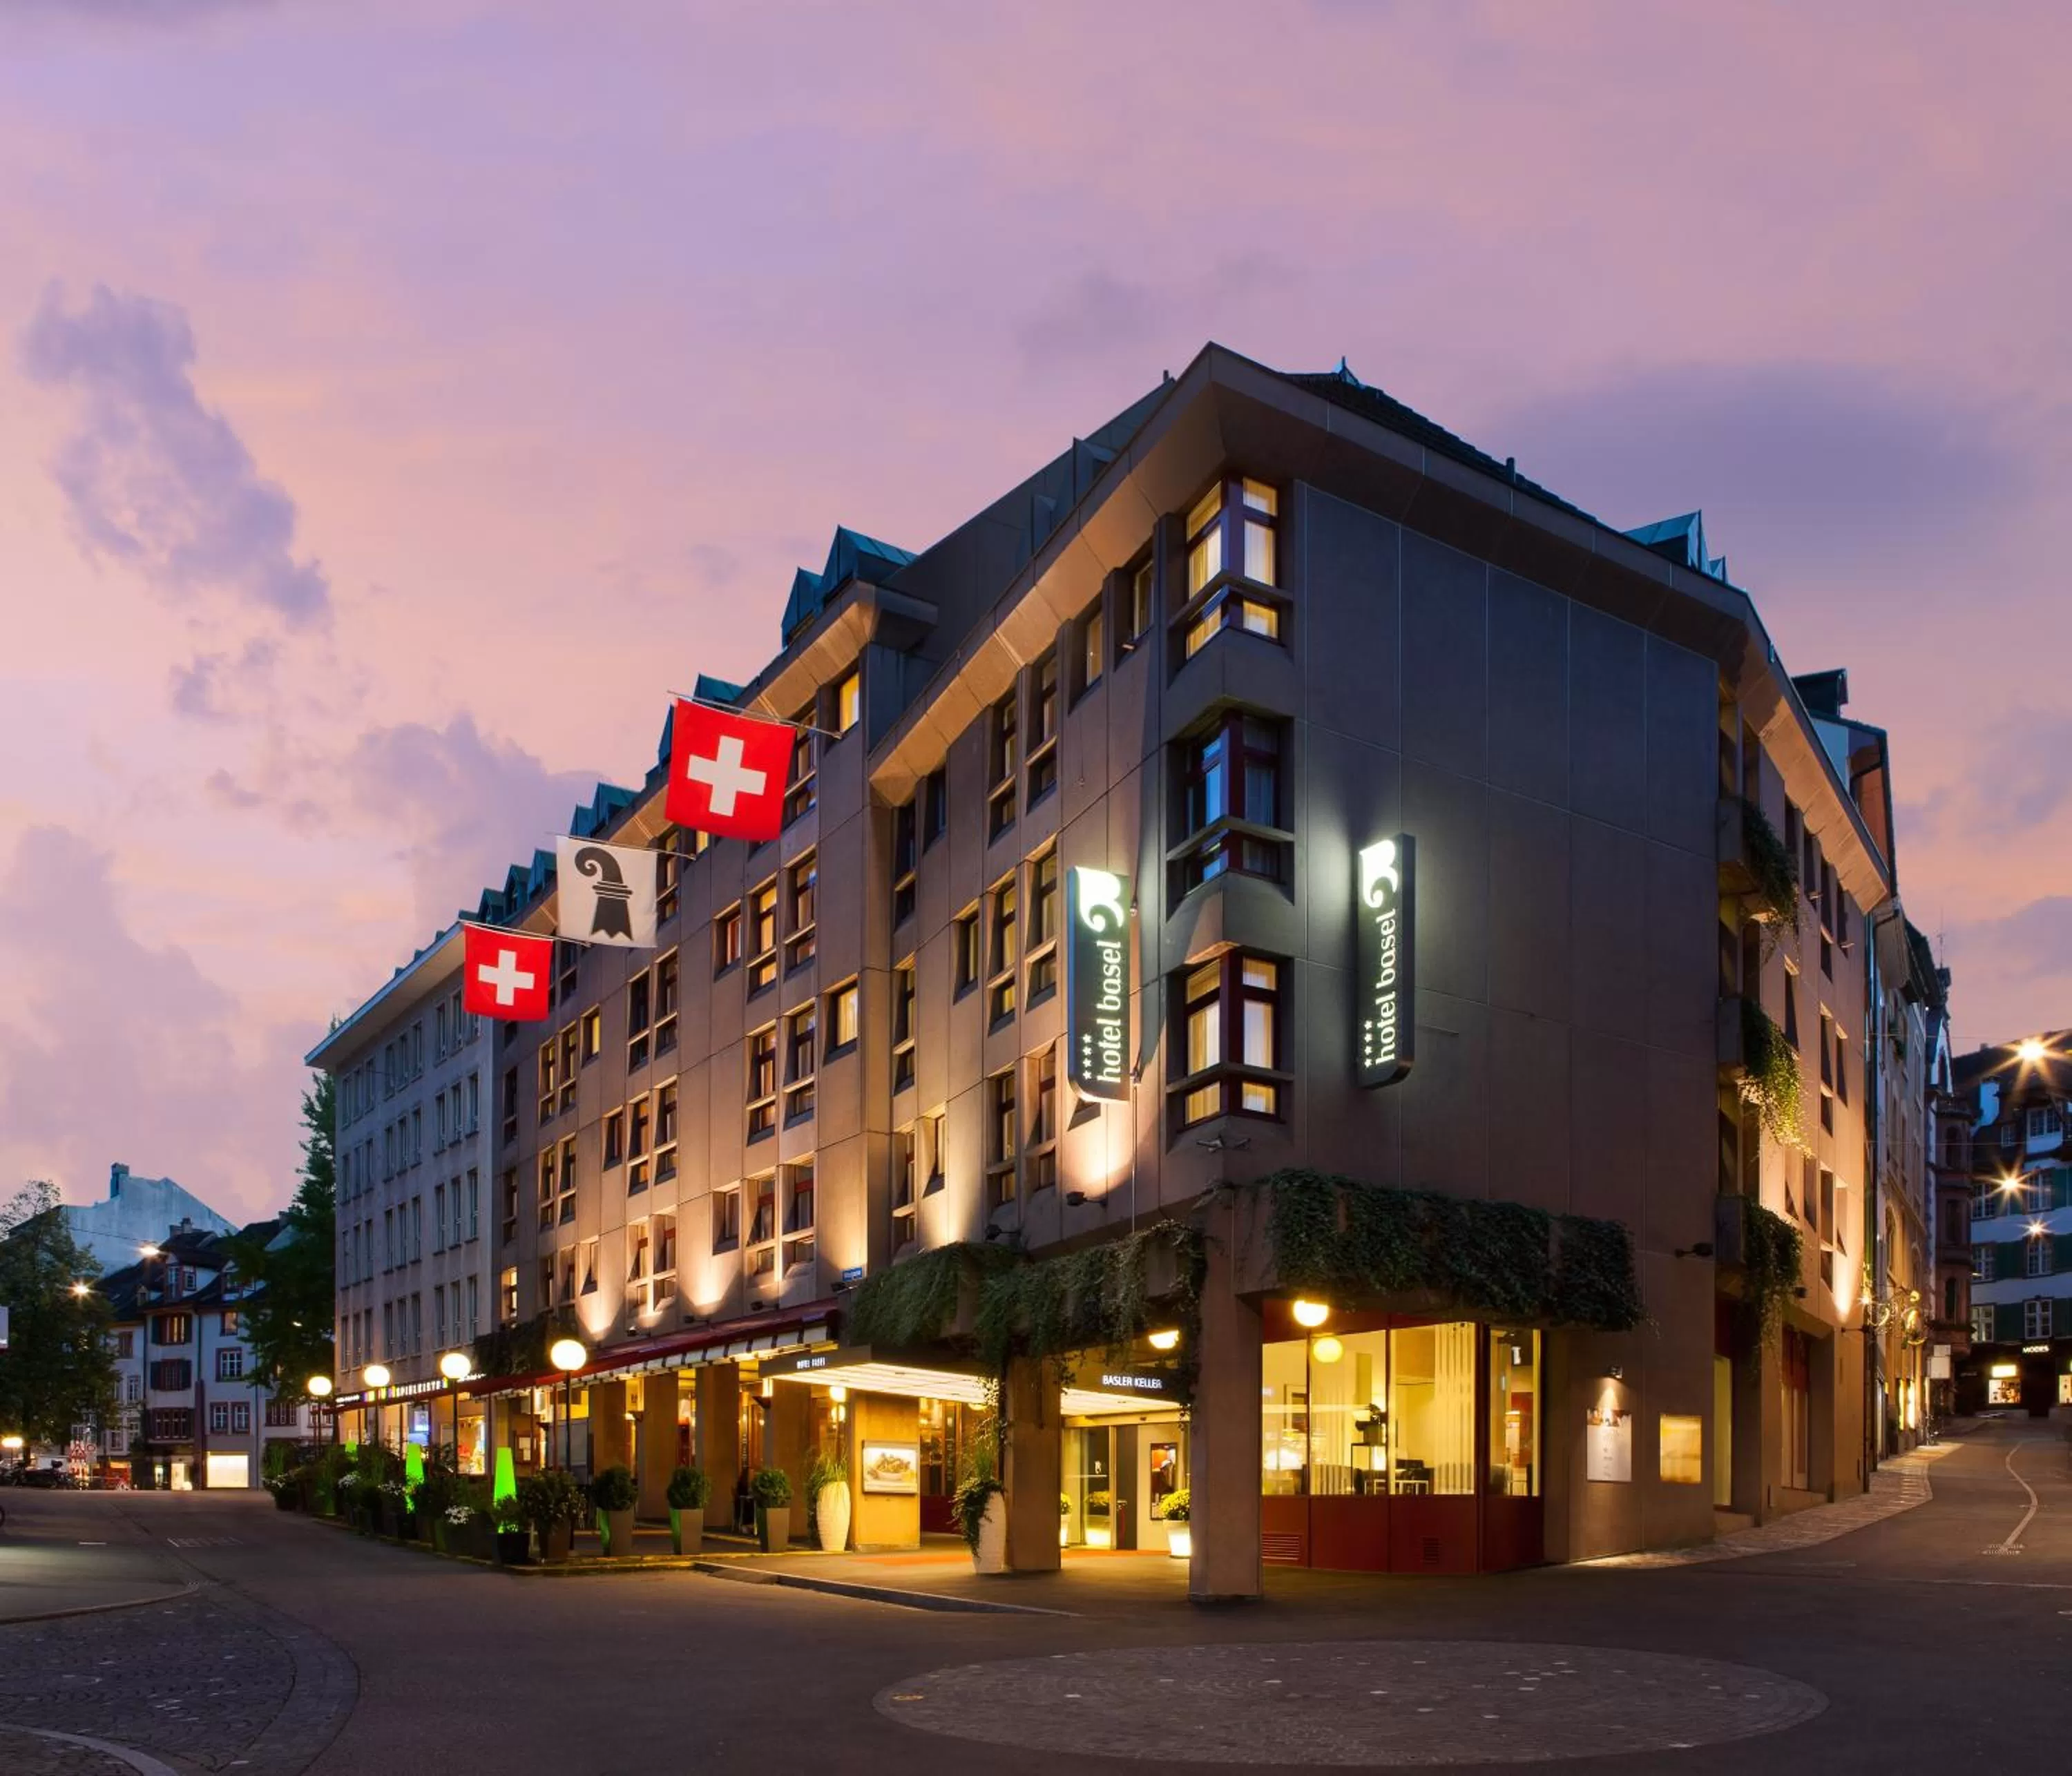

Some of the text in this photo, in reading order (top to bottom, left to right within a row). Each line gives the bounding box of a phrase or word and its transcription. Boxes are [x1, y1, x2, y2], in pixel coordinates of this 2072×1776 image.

[1097, 940, 1122, 1083] hotel basel
[1376, 908, 1396, 1065] hotel basel
[1102, 1375, 1162, 1389] BASLER KELLER
